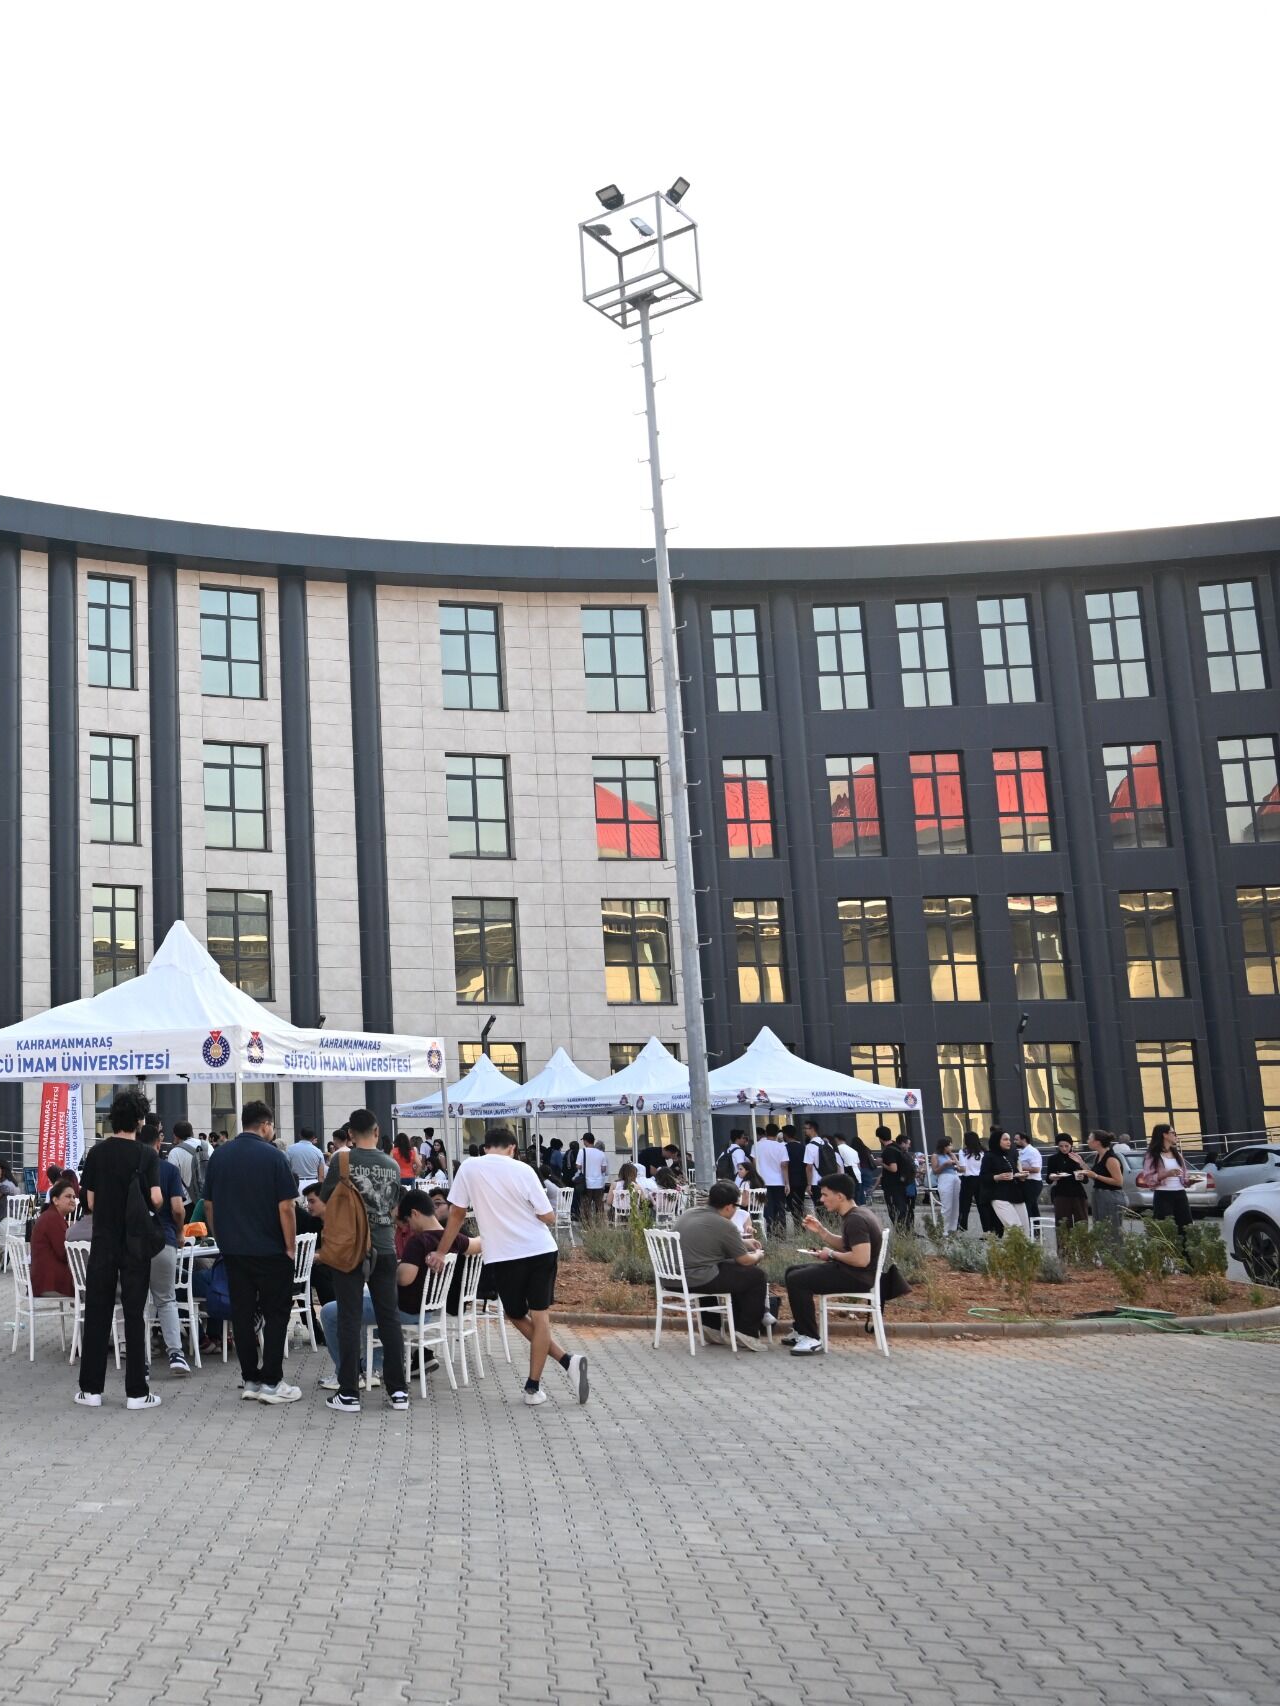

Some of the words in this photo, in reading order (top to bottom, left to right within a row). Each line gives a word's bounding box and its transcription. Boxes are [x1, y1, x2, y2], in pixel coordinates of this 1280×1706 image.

[16, 1036, 113, 1050] KAHRAMANMARAŞ
[319, 1037, 381, 1051] KAHRAMANMARAŞ
[17, 1053, 57, 1073] İMAM
[61, 1048, 170, 1073] ÜNİVERSİTESİ
[284, 1050, 317, 1076] SÜTÇÜ
[319, 1052, 347, 1072] İMAM
[349, 1052, 412, 1073] ÜNİVERSİTESİ
